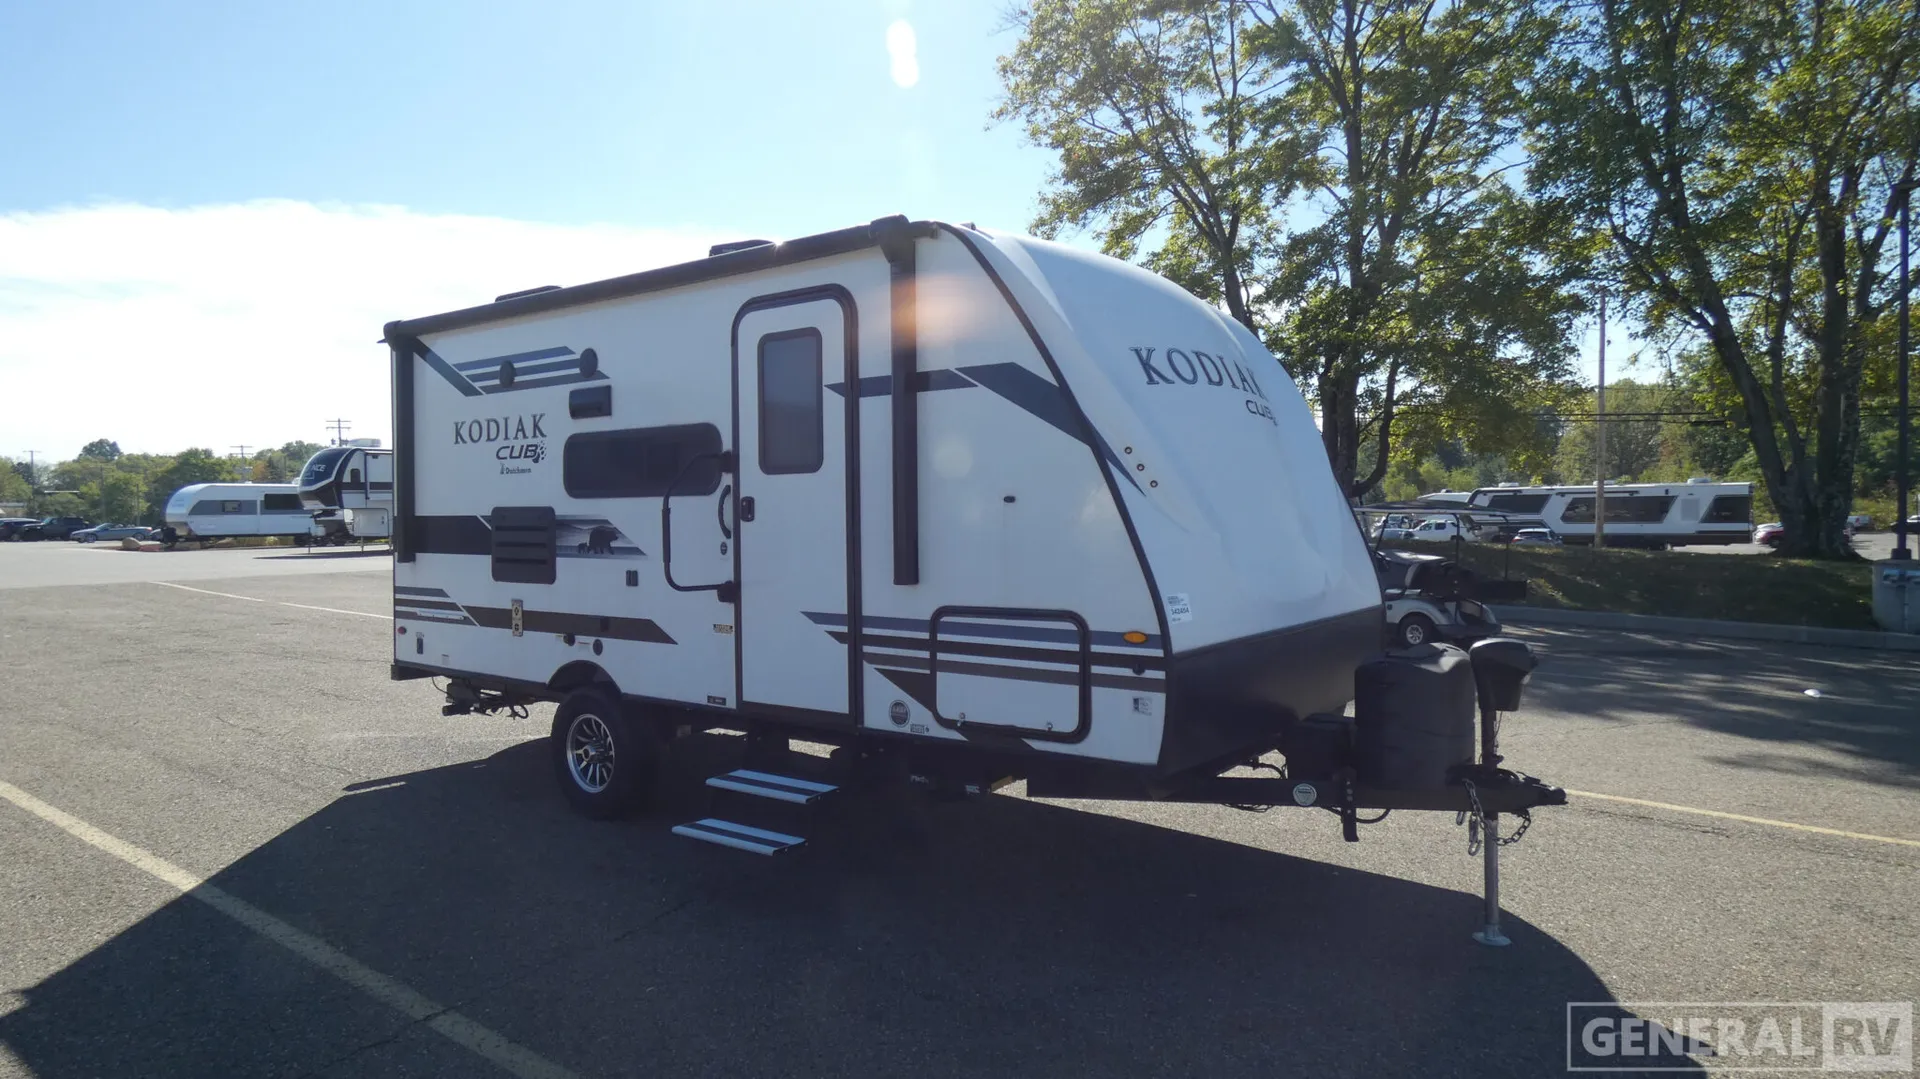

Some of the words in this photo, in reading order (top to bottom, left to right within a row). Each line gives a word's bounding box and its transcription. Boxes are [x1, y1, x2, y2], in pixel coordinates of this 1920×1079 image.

[1245, 399, 1274, 421] CUB
[453, 413, 547, 445] KODIAK
[496, 444, 539, 460] CUB
